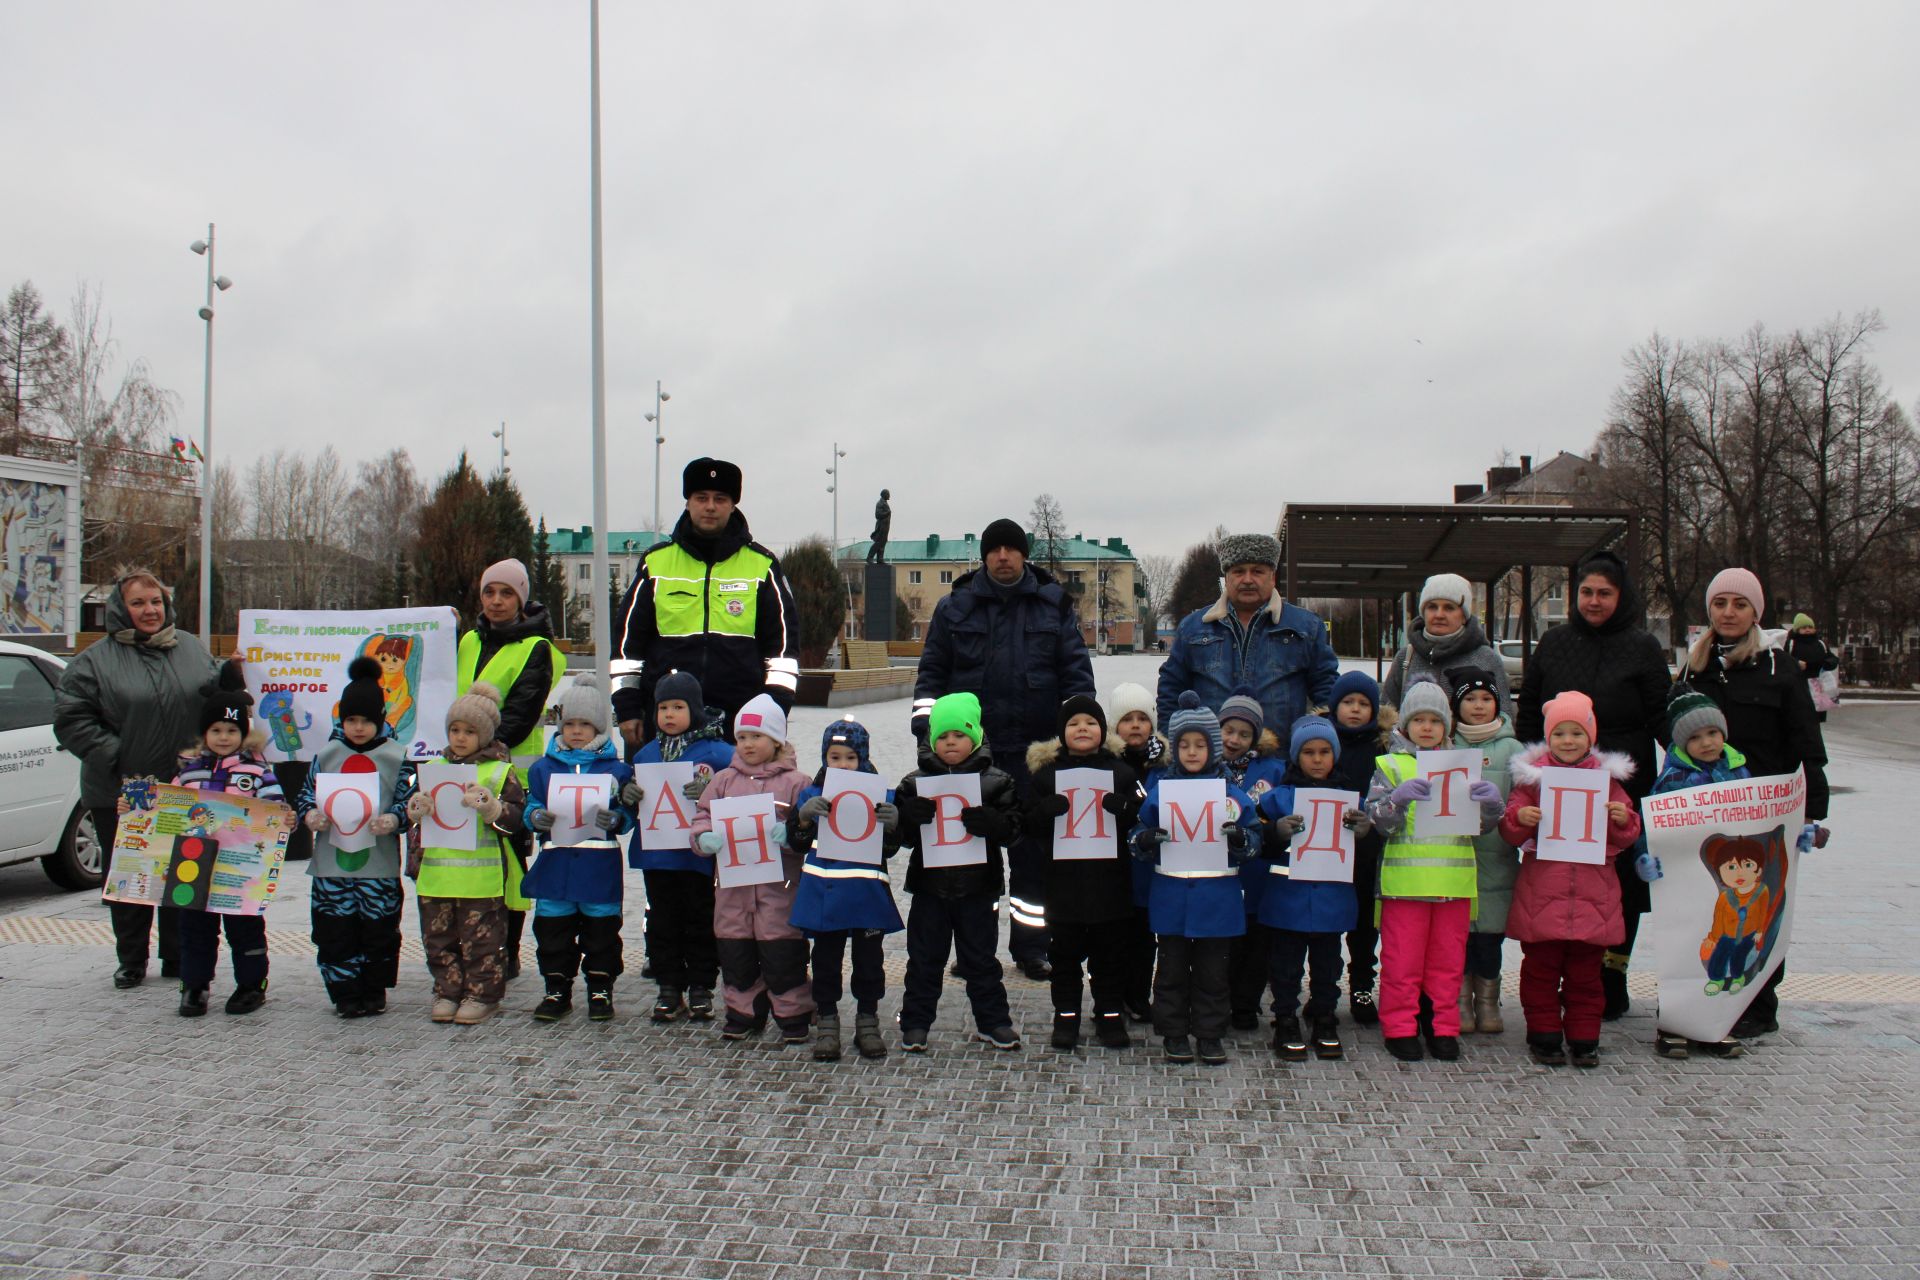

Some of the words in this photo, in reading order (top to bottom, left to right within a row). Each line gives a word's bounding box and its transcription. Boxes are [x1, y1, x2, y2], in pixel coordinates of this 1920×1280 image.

[303, 625, 370, 636] ЛЮБИШЬ
[387, 620, 440, 634] БЕРЕГИ
[246, 646, 341, 663] ПРИСТЕГНИ
[268, 666, 323, 677] САМОЕ
[260, 683, 329, 693] ДОРОГОЕ
[324, 788, 373, 836] О
[430, 781, 469, 830] С
[559, 785, 600, 829] Т
[646, 780, 691, 831] А
[828, 790, 877, 843] О
[1059, 787, 1112, 839] И
[1428, 767, 1469, 817] Т
[1545, 786, 1602, 843] П
[1650, 796, 1688, 812] ПУСТЬ
[1693, 786, 1754, 806] УСЛЫШИТ
[1757, 779, 1793, 801] ЦЕЛЫЙ
[718, 812, 776, 868] Н
[929, 793, 975, 847] В
[1166, 800, 1219, 843] М
[1297, 799, 1349, 864] Д
